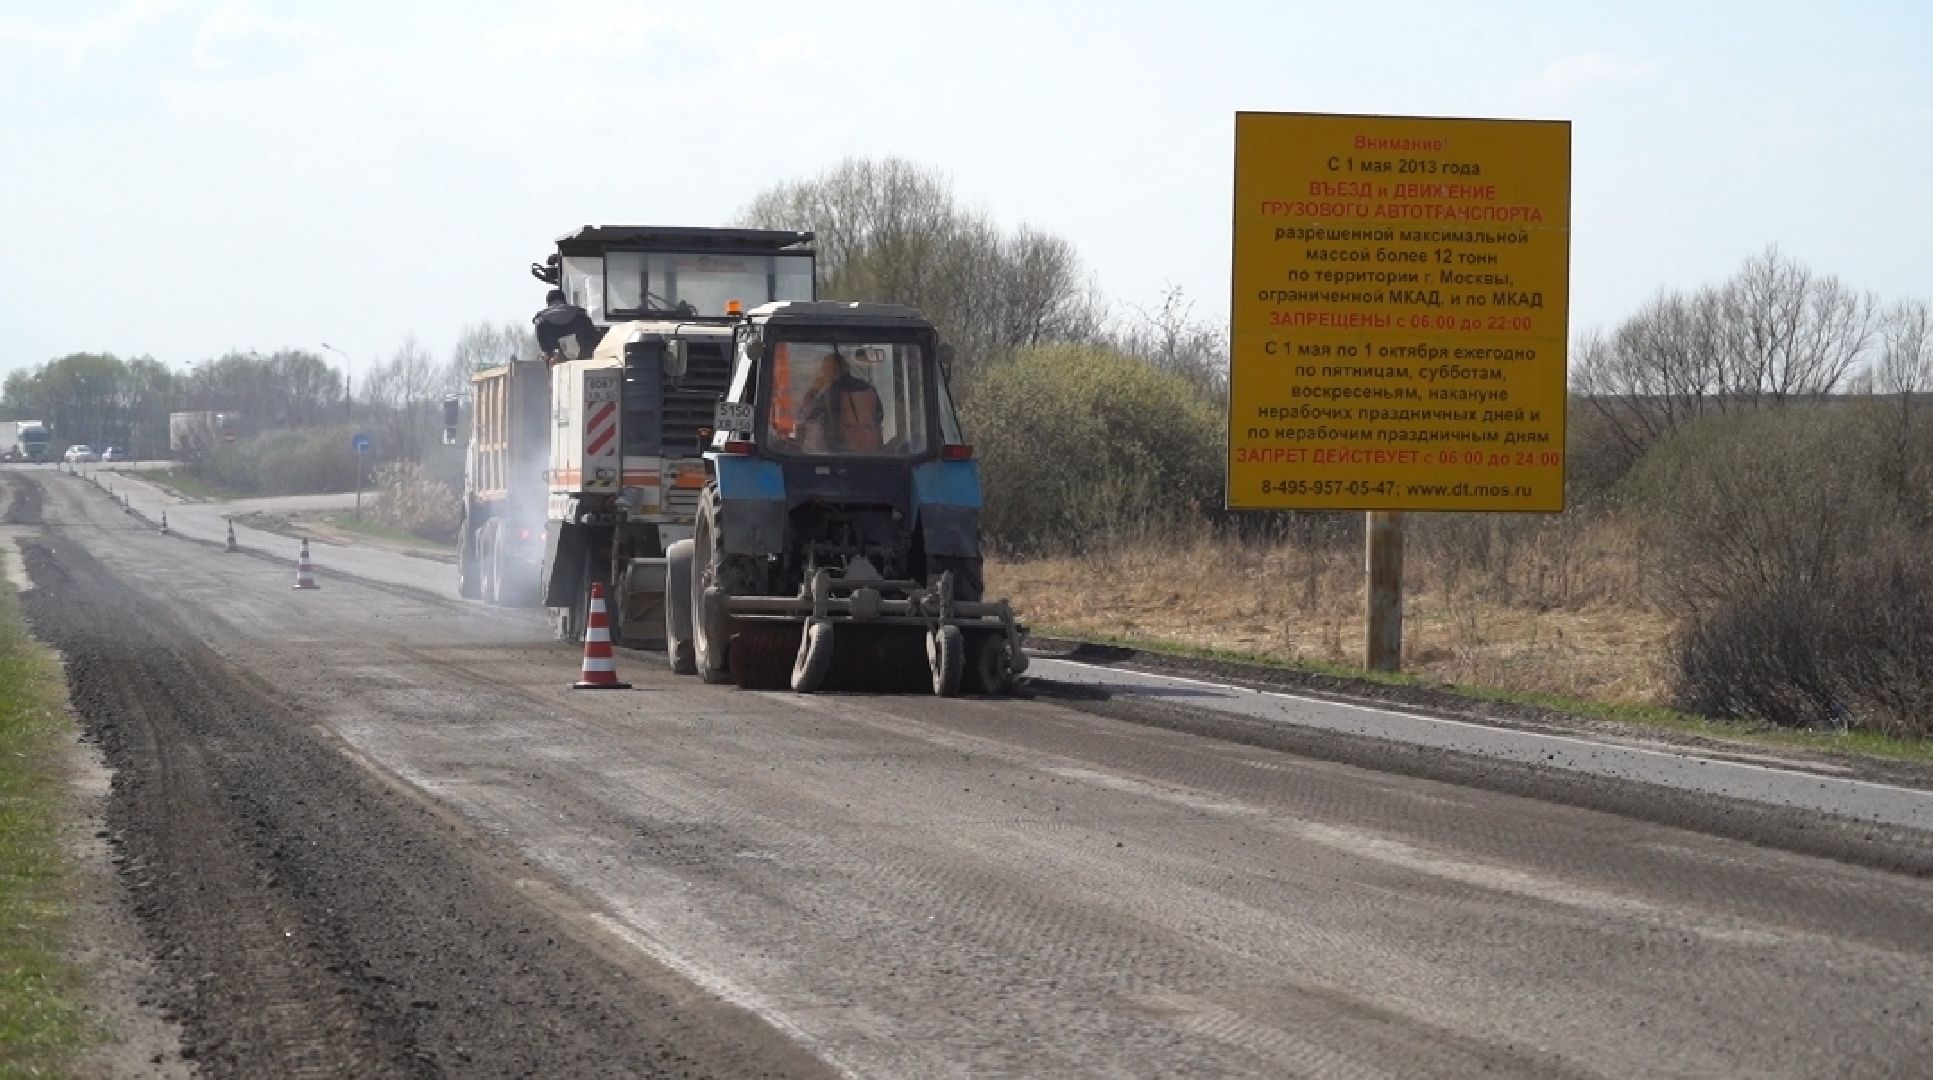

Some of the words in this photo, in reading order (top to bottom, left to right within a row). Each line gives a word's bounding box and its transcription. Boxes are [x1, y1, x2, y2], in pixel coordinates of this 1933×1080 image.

[1355, 135, 1448, 151] Внимание!
[1328, 156, 1340, 171] С
[1347, 157, 1353, 171] 1
[1361, 160, 1392, 172] мая
[1399, 159, 1437, 174] 2013
[1442, 161, 1479, 176] года
[1309, 182, 1373, 198] ВЪЕЗД
[1378, 186, 1388, 197] и
[1393, 184, 1496, 199] ДВИЖЕНИЕ
[1261, 203, 1368, 218] ГРУЗОВОГО
[1375, 207, 1542, 222] АВТОТРАНСПОРТА
[1275, 227, 1393, 242] разрешенной
[1400, 230, 1528, 244] максимальной
[1306, 248, 1370, 262] массой
[1376, 249, 1427, 263] более
[1434, 250, 1452, 264] 12
[1458, 253, 1498, 265] тонн
[1289, 270, 1309, 282] по
[1316, 270, 1418, 284] территории
[1259, 289, 1383, 304] ограниченной
[1450, 294, 1460, 305] и
[1466, 294, 1486, 306] по
[1493, 293, 1543, 309] МКАД
[1270, 311, 1390, 329] ЗАПРЕЩЕНЫ
[1397, 317, 1404, 328] с
[1411, 315, 1455, 330] 06:00
[1460, 318, 1481, 331] до
[1487, 317, 1531, 331] 22:00
[1265, 342, 1277, 355] С
[1284, 342, 1290, 355] 1
[1297, 344, 1331, 356] мая
[1337, 345, 1357, 357] по
[1365, 344, 1371, 357] 1
[1378, 344, 1448, 360] октября
[1454, 348, 1536, 361] ежегодно
[1295, 365, 1316, 376] по
[1429, 388, 1508, 403] накануне
[1259, 405, 1352, 420] нерабочих
[1358, 408, 1476, 422] праздничных
[1483, 407, 1524, 422] дней
[1530, 411, 1540, 421] и
[1248, 427, 1269, 438] по
[1275, 427, 1372, 442] нерабочим
[1377, 429, 1498, 444] праздничным
[1504, 431, 1549, 443] дням
[1236, 448, 1307, 463] ЗАПРЕТ
[1313, 447, 1418, 465] ДЕЙСТВУЕТ
[1424, 454, 1431, 464] с
[1439, 451, 1483, 465] 06:00
[1488, 454, 1510, 467] до
[1516, 452, 1558, 465] 24:00
[1407, 481, 1532, 497] www.dt.mos.ru
